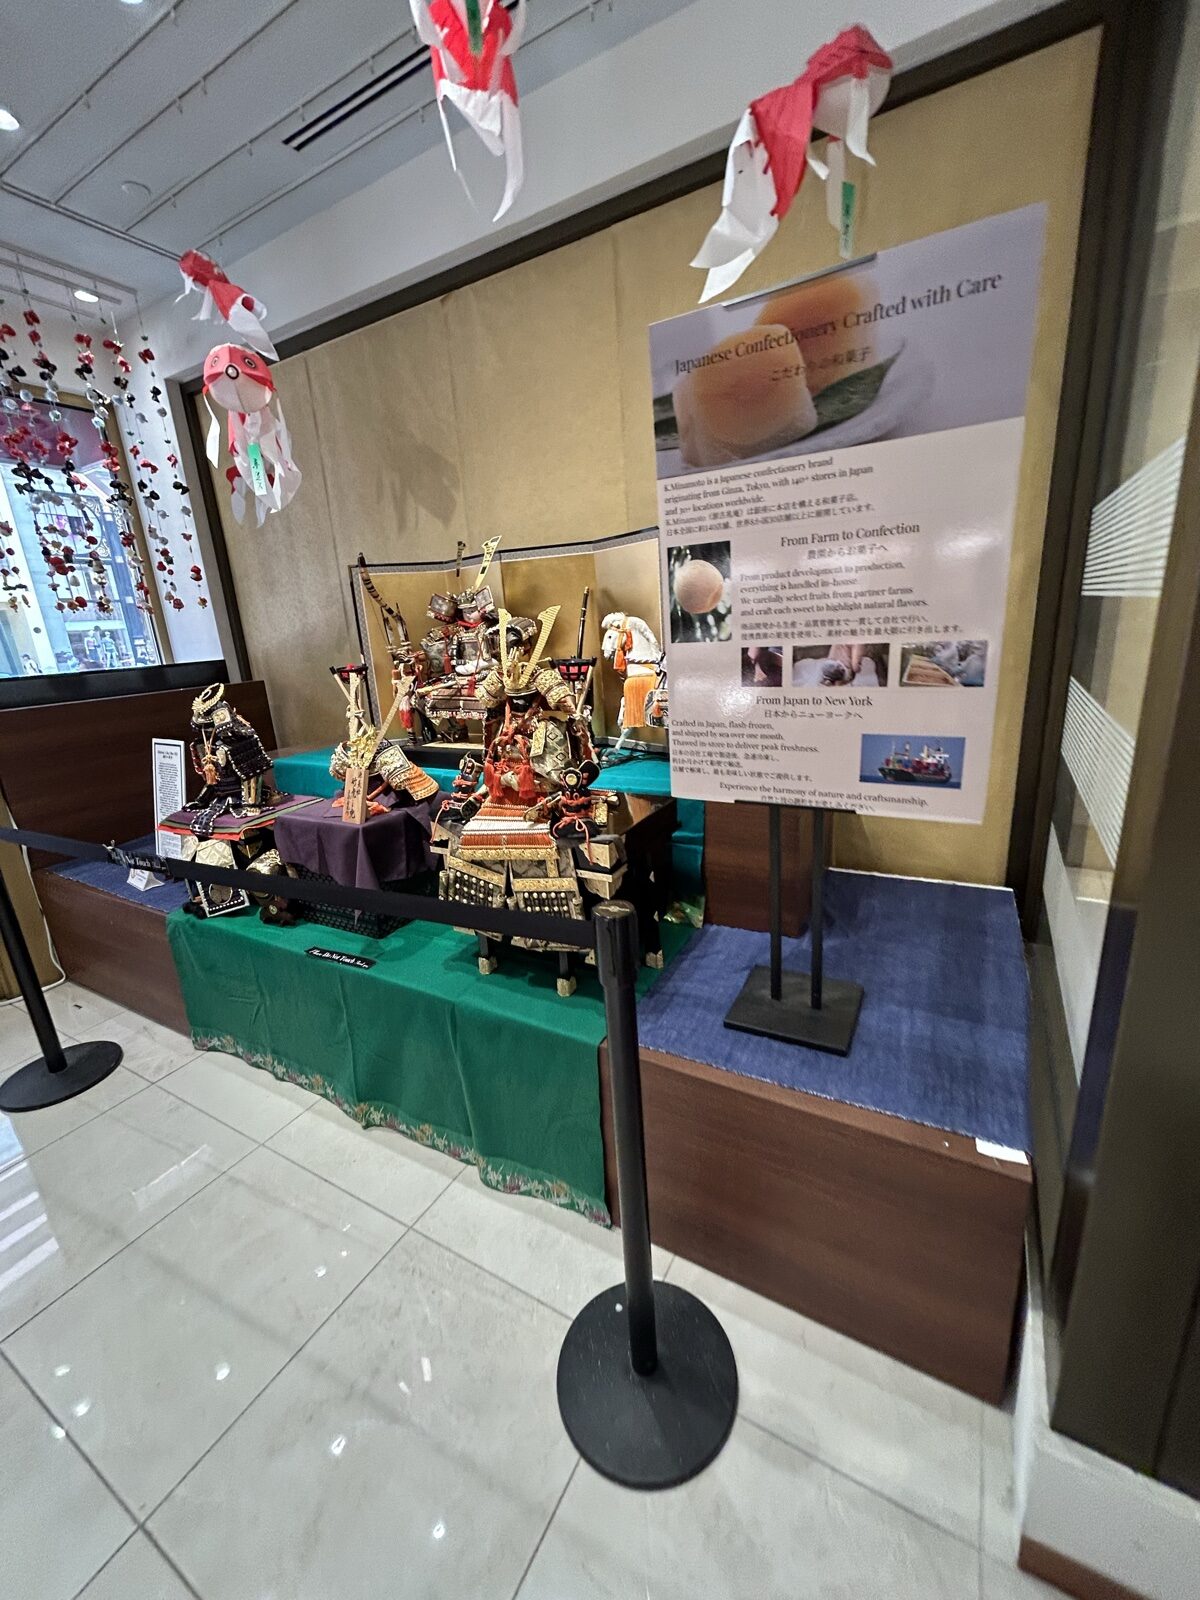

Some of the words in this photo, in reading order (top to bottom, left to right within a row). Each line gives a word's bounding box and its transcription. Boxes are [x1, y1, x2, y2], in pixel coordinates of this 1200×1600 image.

[674, 346, 732, 375] Japanese
[735, 319, 837, 357] Confectionery
[843, 295, 906, 329] Crafted
[909, 287, 951, 313] with
[955, 272, 1002, 299] Care
[720, 472, 752, 484] Japanese
[753, 463, 806, 477] confectionery
[808, 456, 833, 468] brand
[664, 492, 701, 504] originating
[703, 489, 720, 499] from
[721, 486, 744, 495] Ginza,
[772, 477, 789, 487] with
[811, 472, 837, 481] stores
[839, 468, 847, 477] in
[849, 466, 874, 477] Japan
[665, 507, 677, 516] and
[692, 502, 723, 512] locations
[781, 535, 808, 547] From
[811, 532, 839, 544] Farm
[842, 530, 854, 540] to
[856, 522, 920, 539] Confection
[740, 573, 759, 581] From
[761, 569, 791, 581] product
[792, 566, 842, 577] development
[740, 584, 779, 593] everything
[780, 582, 787, 590] is
[788, 580, 819, 589] handled
[740, 596, 750, 604] We
[753, 595, 784, 604] carefully
[786, 593, 807, 601] select
[809, 592, 830, 600] fruits
[832, 590, 852, 599] from
[854, 589, 886, 599] partner
[741, 608, 754, 616] and
[755, 607, 772, 615] craft
[774, 605, 791, 614] each
[793, 605, 814, 613] sweet
[816, 604, 824, 612] to
[825, 601, 861, 612] highlight
[864, 600, 894, 609] natural
[756, 696, 781, 706] From
[783, 696, 809, 707] Japan
[812, 697, 822, 705] to
[825, 696, 846, 706] New
[848, 696, 873, 706] York
[671, 720, 696, 728] Crafted
[705, 720, 727, 729] Japan,
[685, 730, 708, 738] shipped
[673, 739, 698, 747] Thawed
[734, 741, 760, 750] deliver
[761, 742, 779, 752] peak
[720, 782, 758, 791] Experience
[759, 785, 772, 793] the
[773, 786, 806, 797] harmony
[818, 791, 845, 799] nature
[846, 792, 862, 800] and
